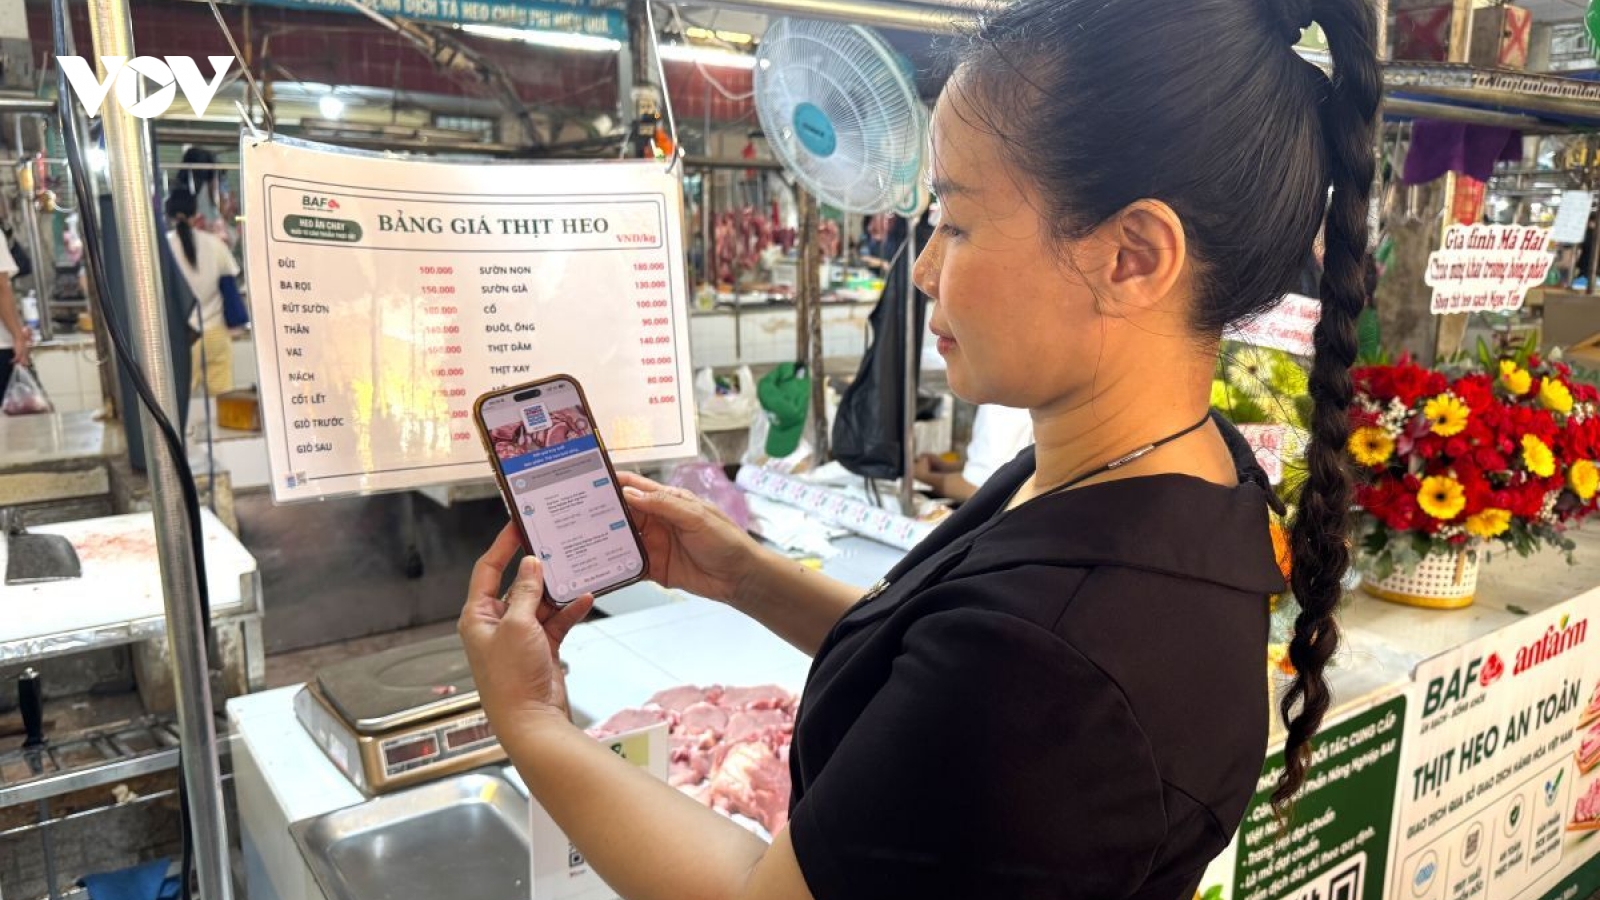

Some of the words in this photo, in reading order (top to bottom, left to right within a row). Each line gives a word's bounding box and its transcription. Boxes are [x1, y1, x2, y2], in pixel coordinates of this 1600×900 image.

[302, 195, 328, 207] BAF
[378, 210, 442, 234] BẢNG
[450, 216, 492, 235] GIÁ
[497, 218, 553, 238] THỊT
[562, 218, 609, 234] HEO
[1445, 227, 1465, 250] Gia
[1519, 229, 1548, 251] Hai
[278, 258, 296, 269] ĐÙI
[479, 265, 507, 275] SƯỜN
[509, 266, 532, 275] NON
[280, 281, 293, 290] BA
[294, 281, 312, 292] RỌI
[481, 284, 509, 294] SƯỜN
[285, 347, 303, 357] VAI
[1421, 656, 1482, 719] BAF
[1512, 617, 1588, 677] anfarm
[1413, 748, 1455, 801] THỊT
[1459, 725, 1499, 774] HEO
[1503, 706, 1531, 748] AN
